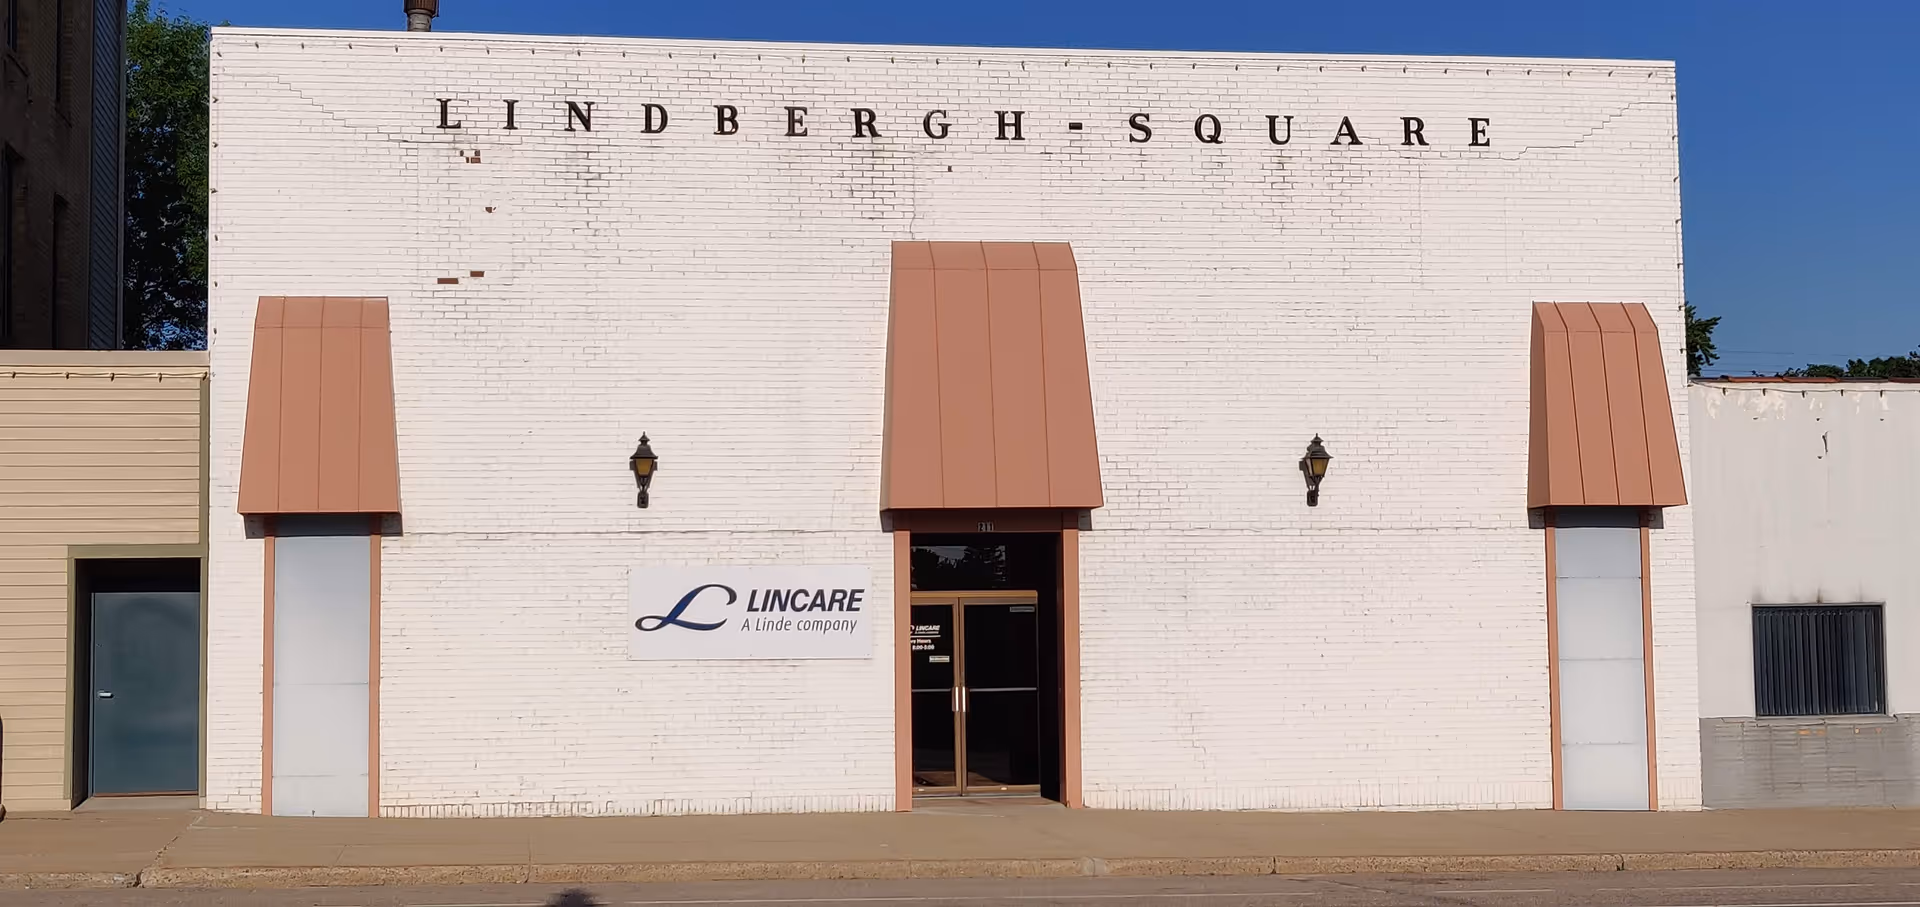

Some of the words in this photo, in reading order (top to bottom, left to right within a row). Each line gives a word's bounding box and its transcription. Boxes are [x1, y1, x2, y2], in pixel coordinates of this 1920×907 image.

[747, 589, 865, 612] LINCARE
[741, 617, 750, 631] A
[755, 617, 792, 632] Linde
[796, 618, 858, 635] company
